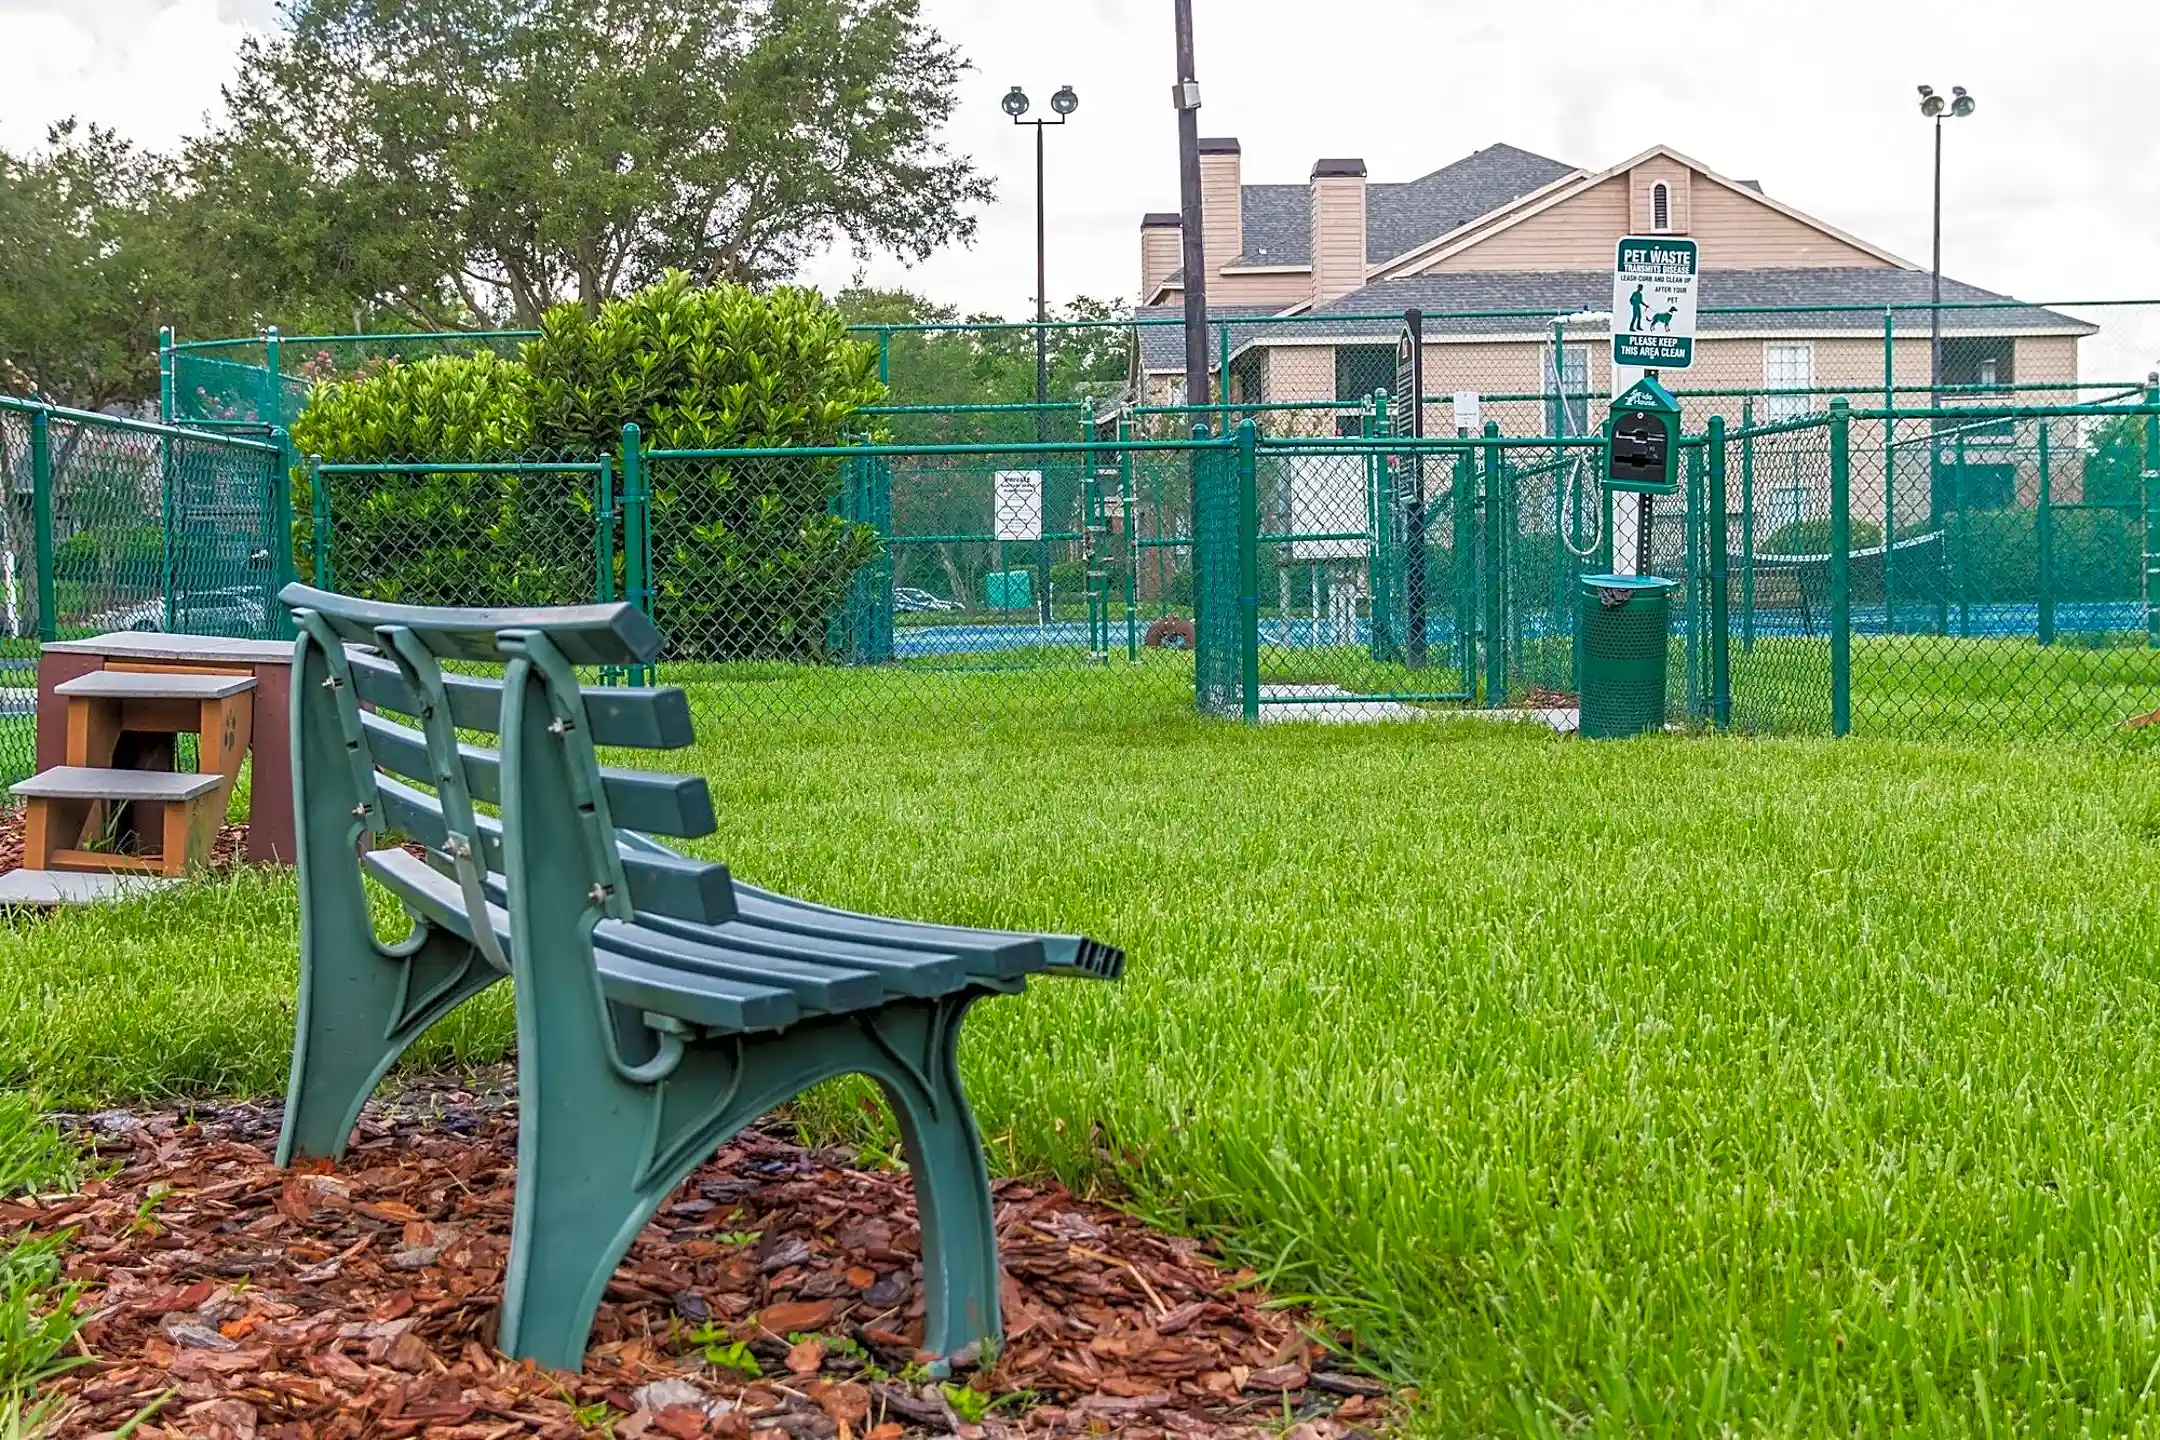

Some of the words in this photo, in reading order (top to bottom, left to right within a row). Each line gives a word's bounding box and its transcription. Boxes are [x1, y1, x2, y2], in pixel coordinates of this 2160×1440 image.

[1624, 249, 1646, 263] PET
[1650, 250, 1691, 264] WASTE
[1624, 265, 1661, 273] TRANSMITS
[1663, 266, 1690, 274] DISEASE
[1655, 286, 1672, 294] AFTER
[1667, 296, 1678, 304] PET
[1629, 336, 1657, 347] PLEASE
[1658, 337, 1678, 347] KEEP
[1621, 345, 1638, 355] THIS
[1639, 347, 1660, 357] AREA
[1661, 348, 1686, 358] CLEAN
